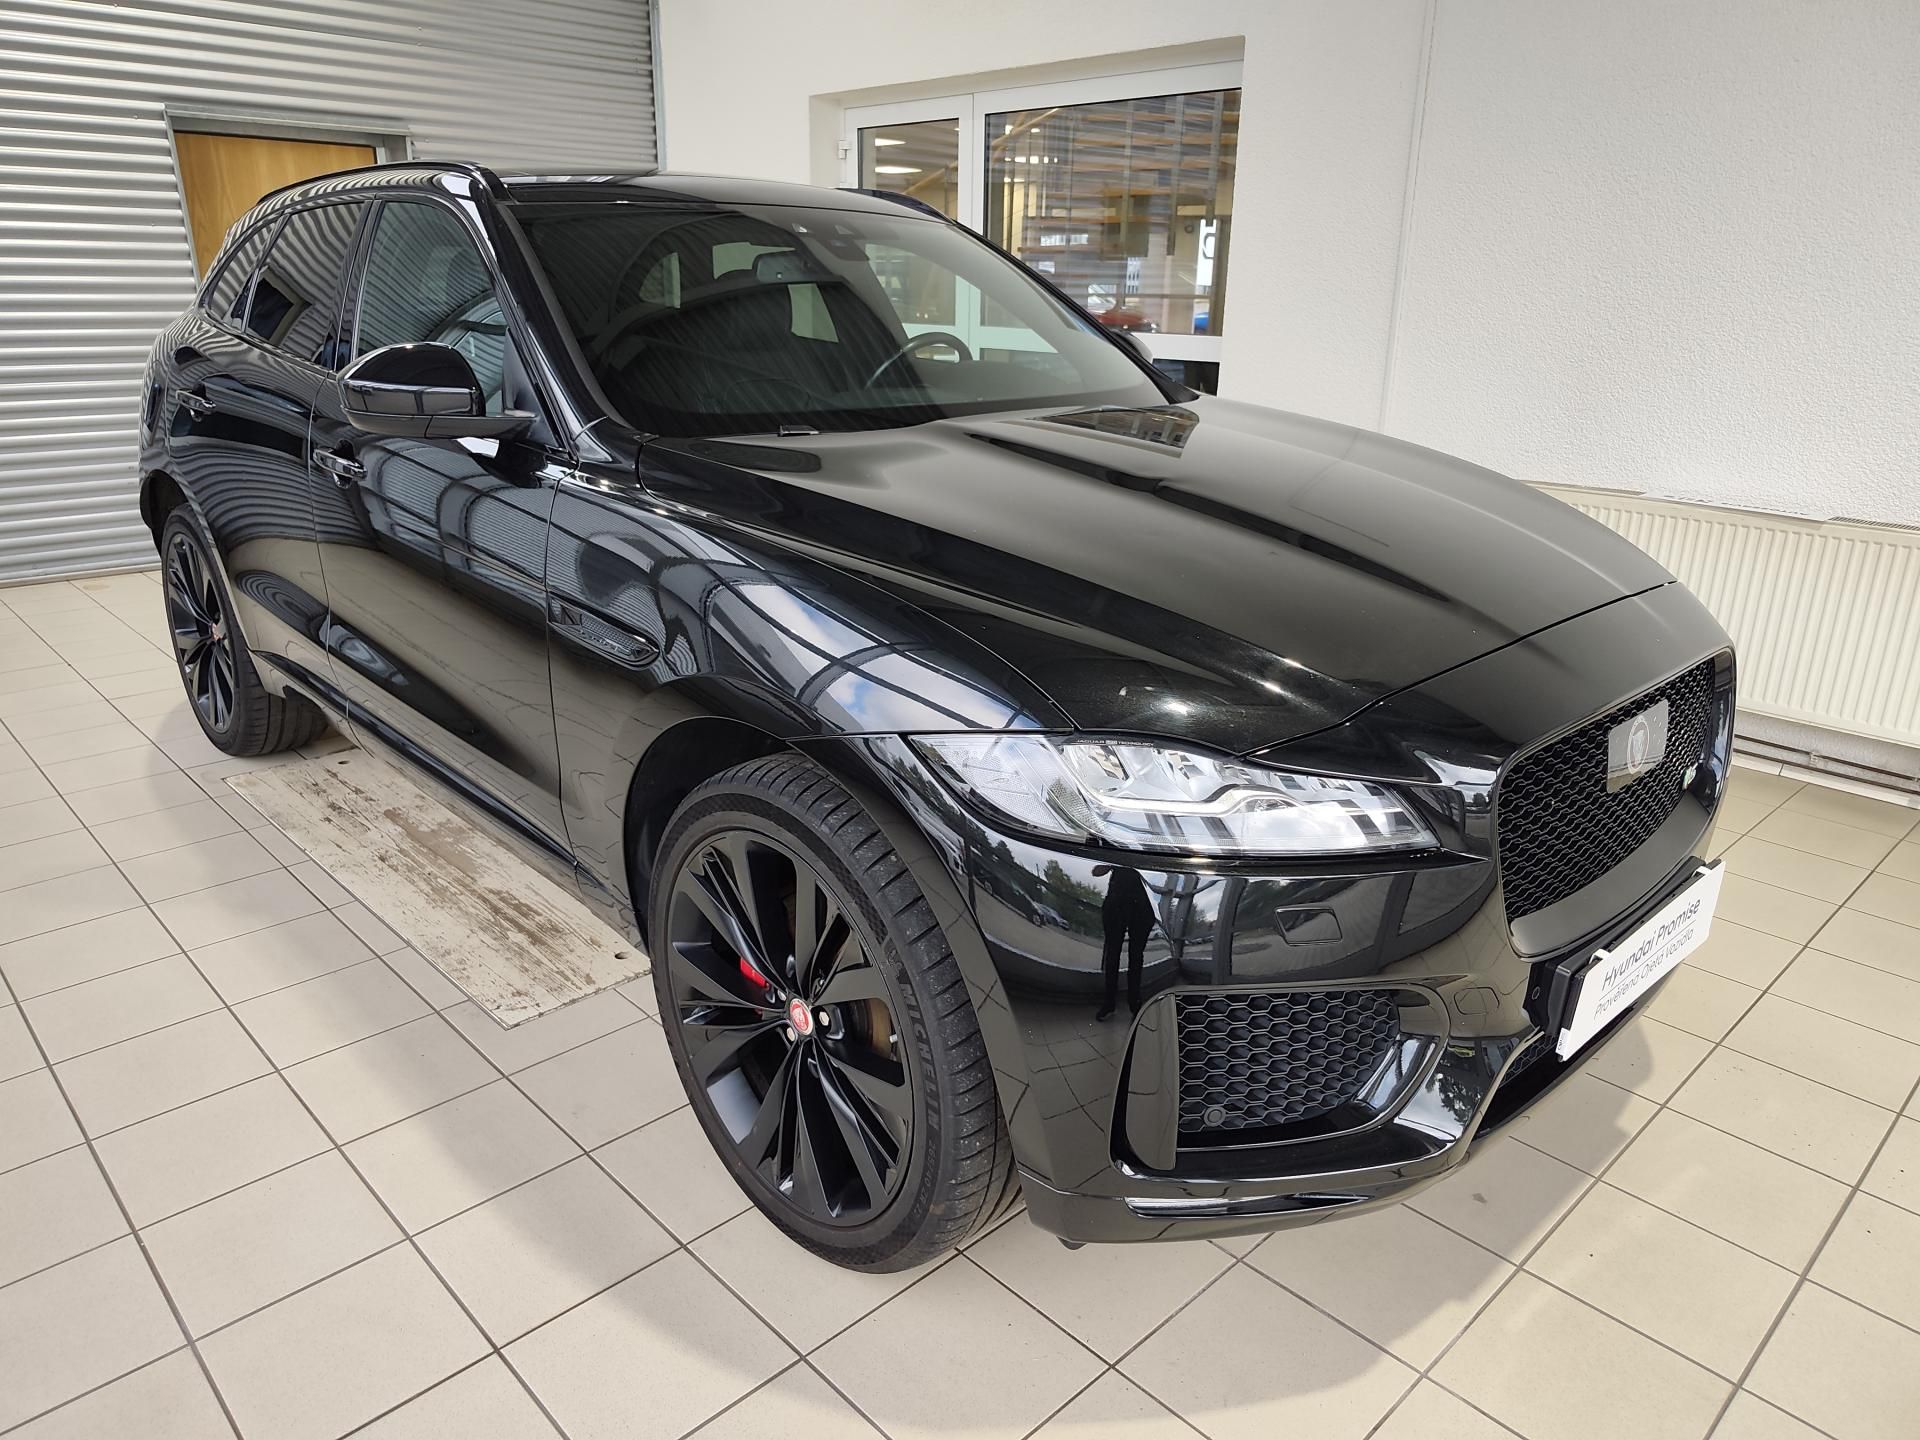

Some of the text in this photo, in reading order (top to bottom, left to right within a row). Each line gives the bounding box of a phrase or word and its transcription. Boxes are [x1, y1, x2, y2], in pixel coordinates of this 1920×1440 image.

[1602, 899, 1701, 992] Hyundai Promise
[900, 983, 940, 1130] MICHELIN
